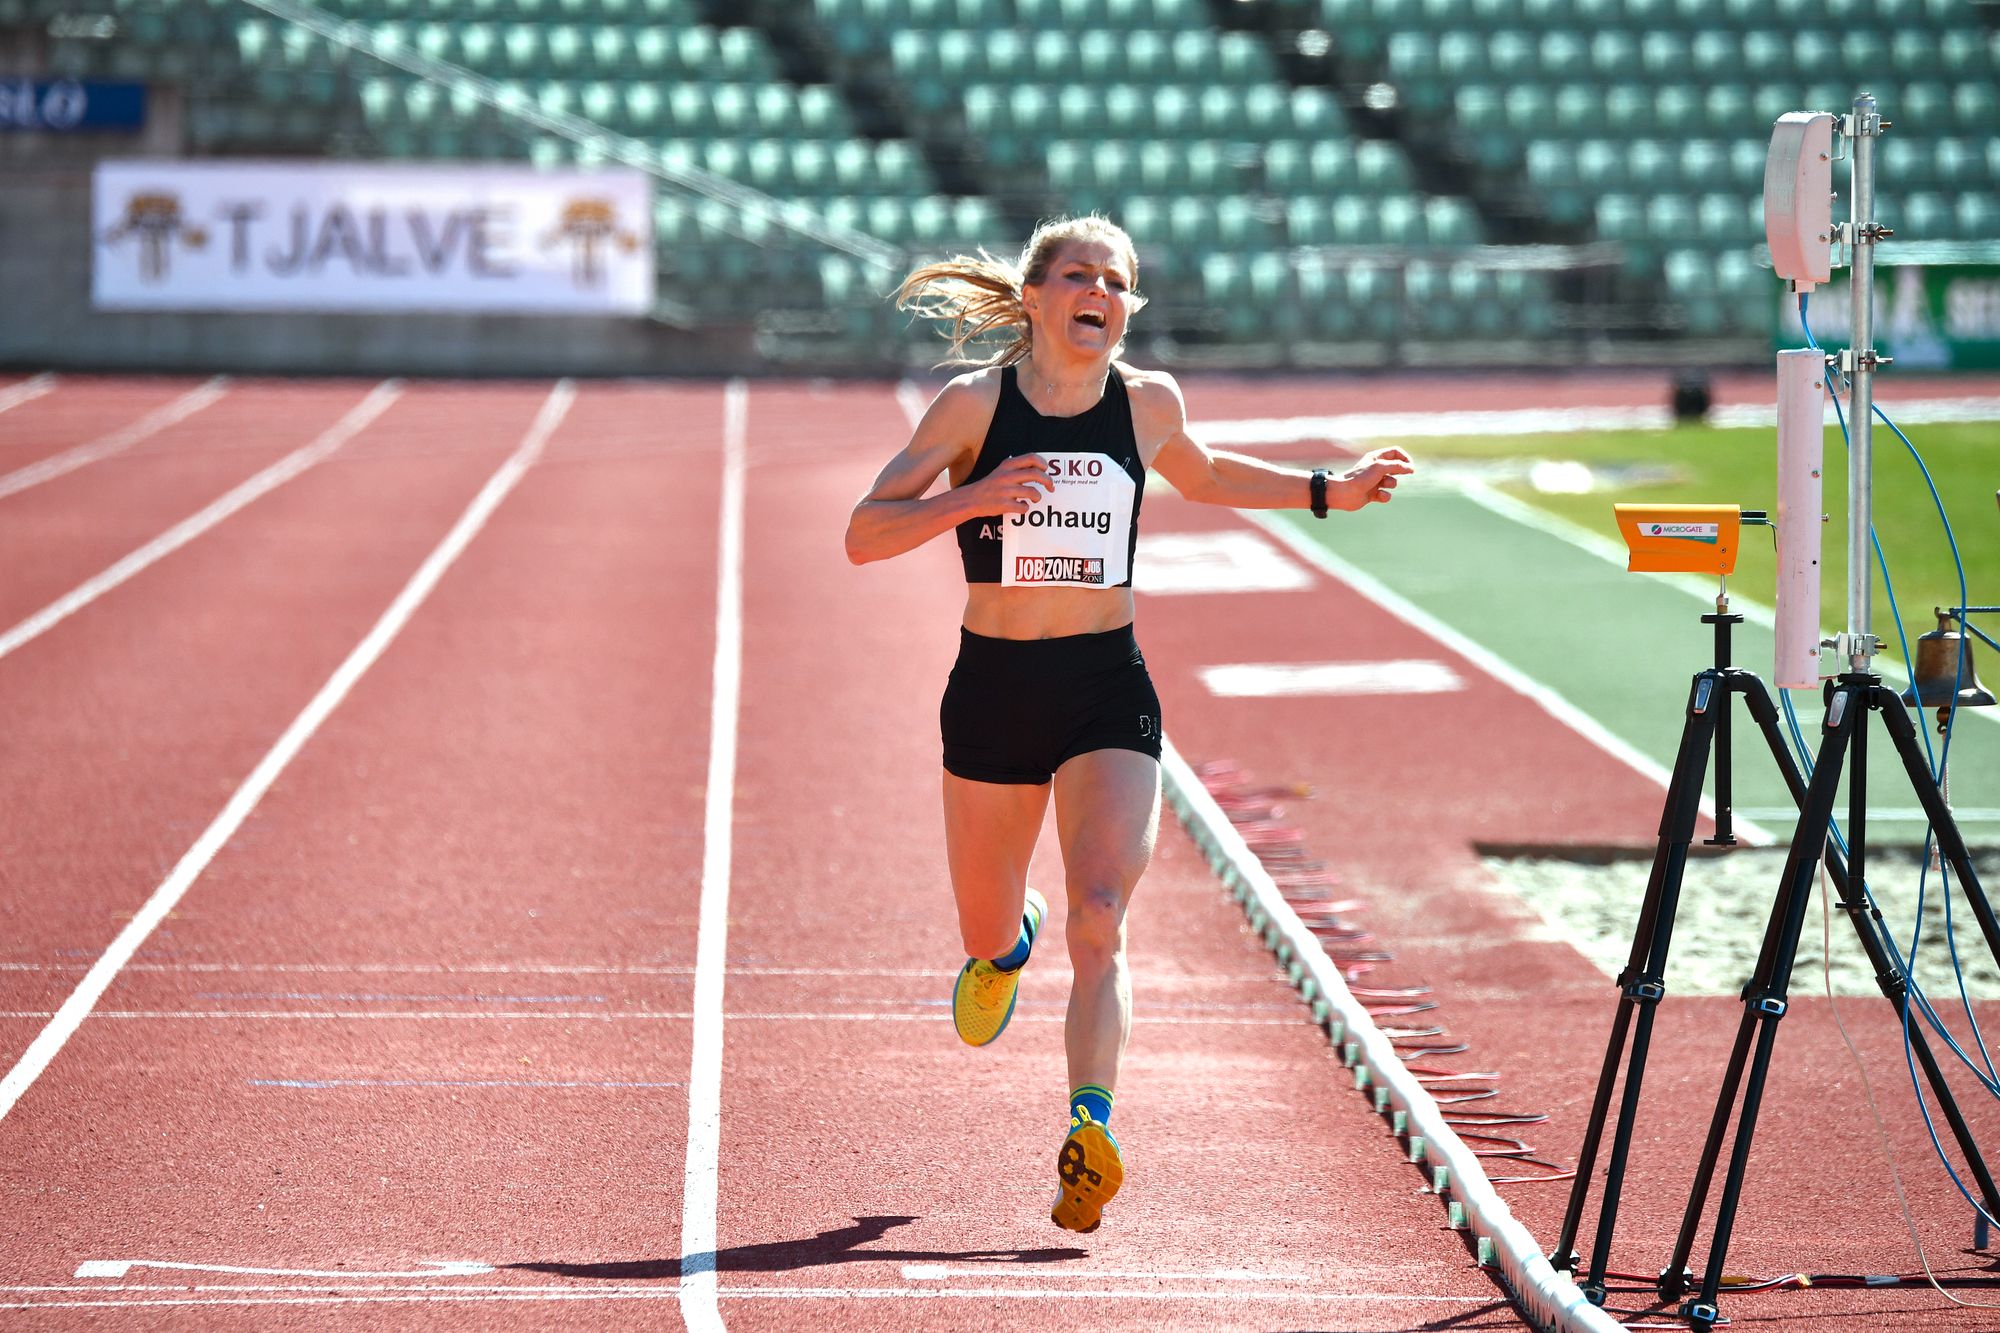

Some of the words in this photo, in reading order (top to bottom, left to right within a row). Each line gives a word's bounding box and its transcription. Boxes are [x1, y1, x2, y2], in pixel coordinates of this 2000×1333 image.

[215, 200, 518, 281] TJALVE
[1011, 505, 1111, 535] Johaug
[1085, 560, 1101, 574] JOB
[1082, 575, 1104, 583] ZONE
